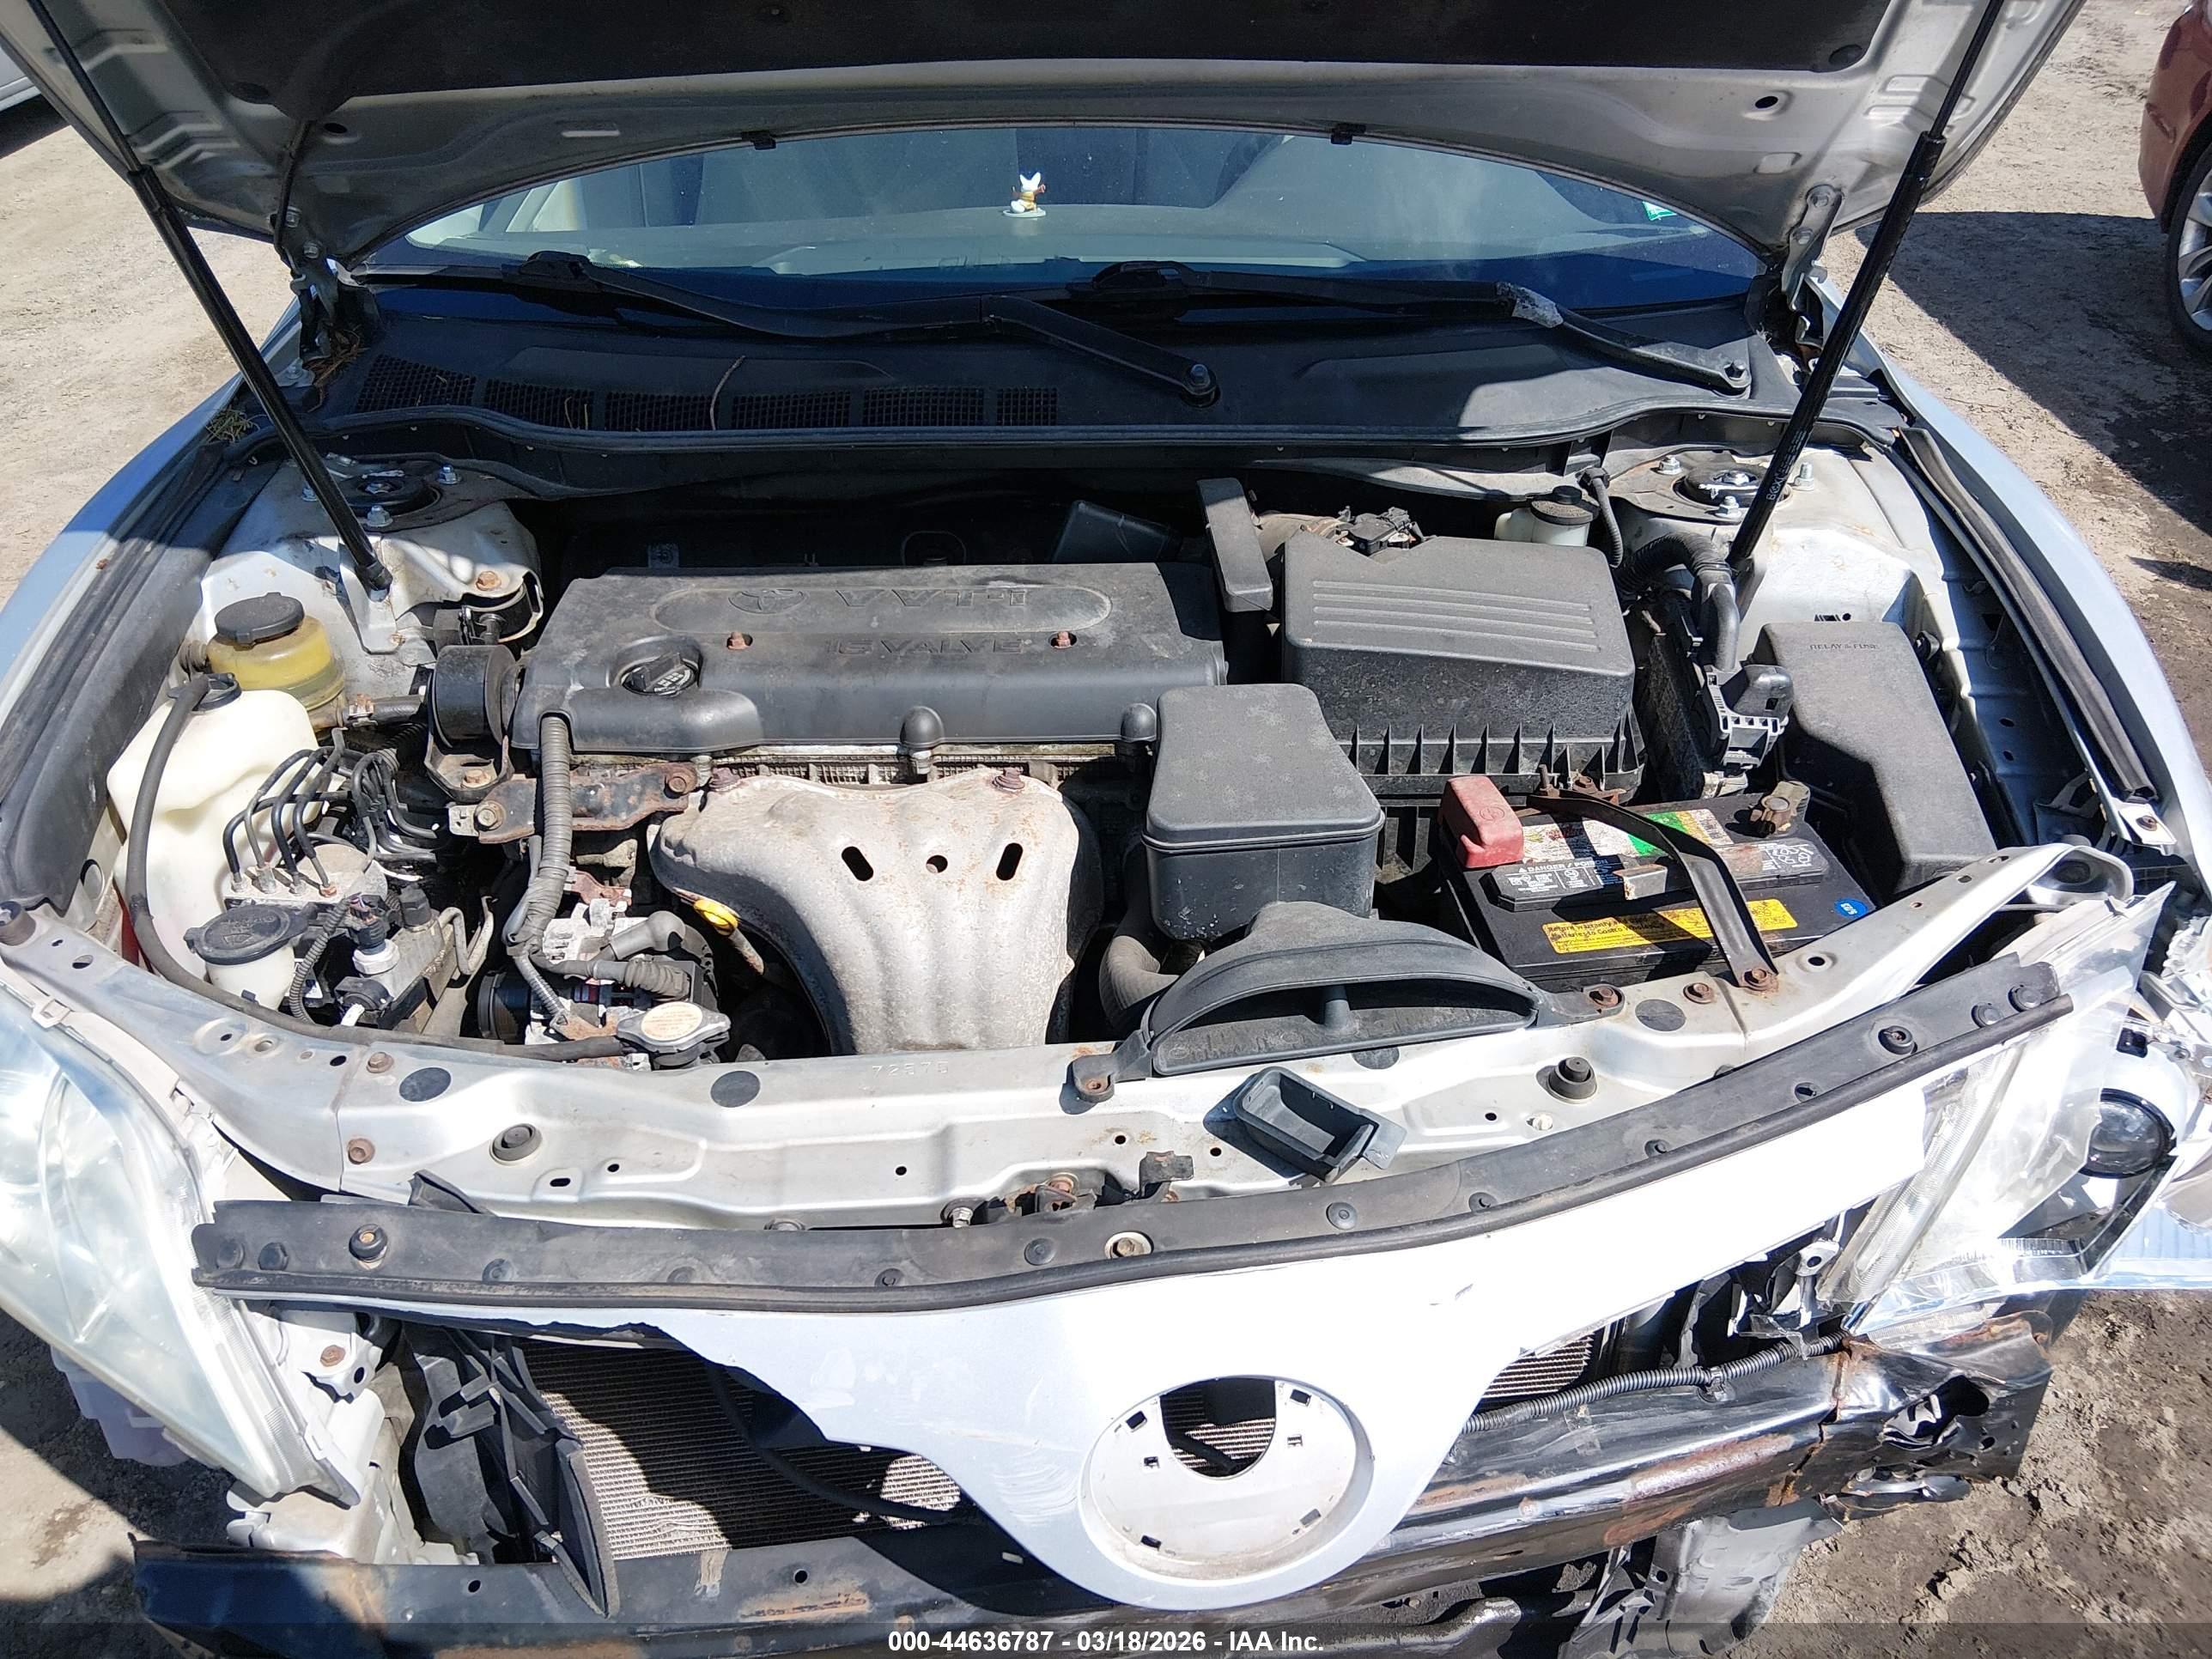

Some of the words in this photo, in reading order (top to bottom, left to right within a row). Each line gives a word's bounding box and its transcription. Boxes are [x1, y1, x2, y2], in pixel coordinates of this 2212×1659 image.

[879, 638, 1024, 655] VALVE
[1528, 863, 1565, 872] DANGER
[1597, 926, 1623, 934] Costco
